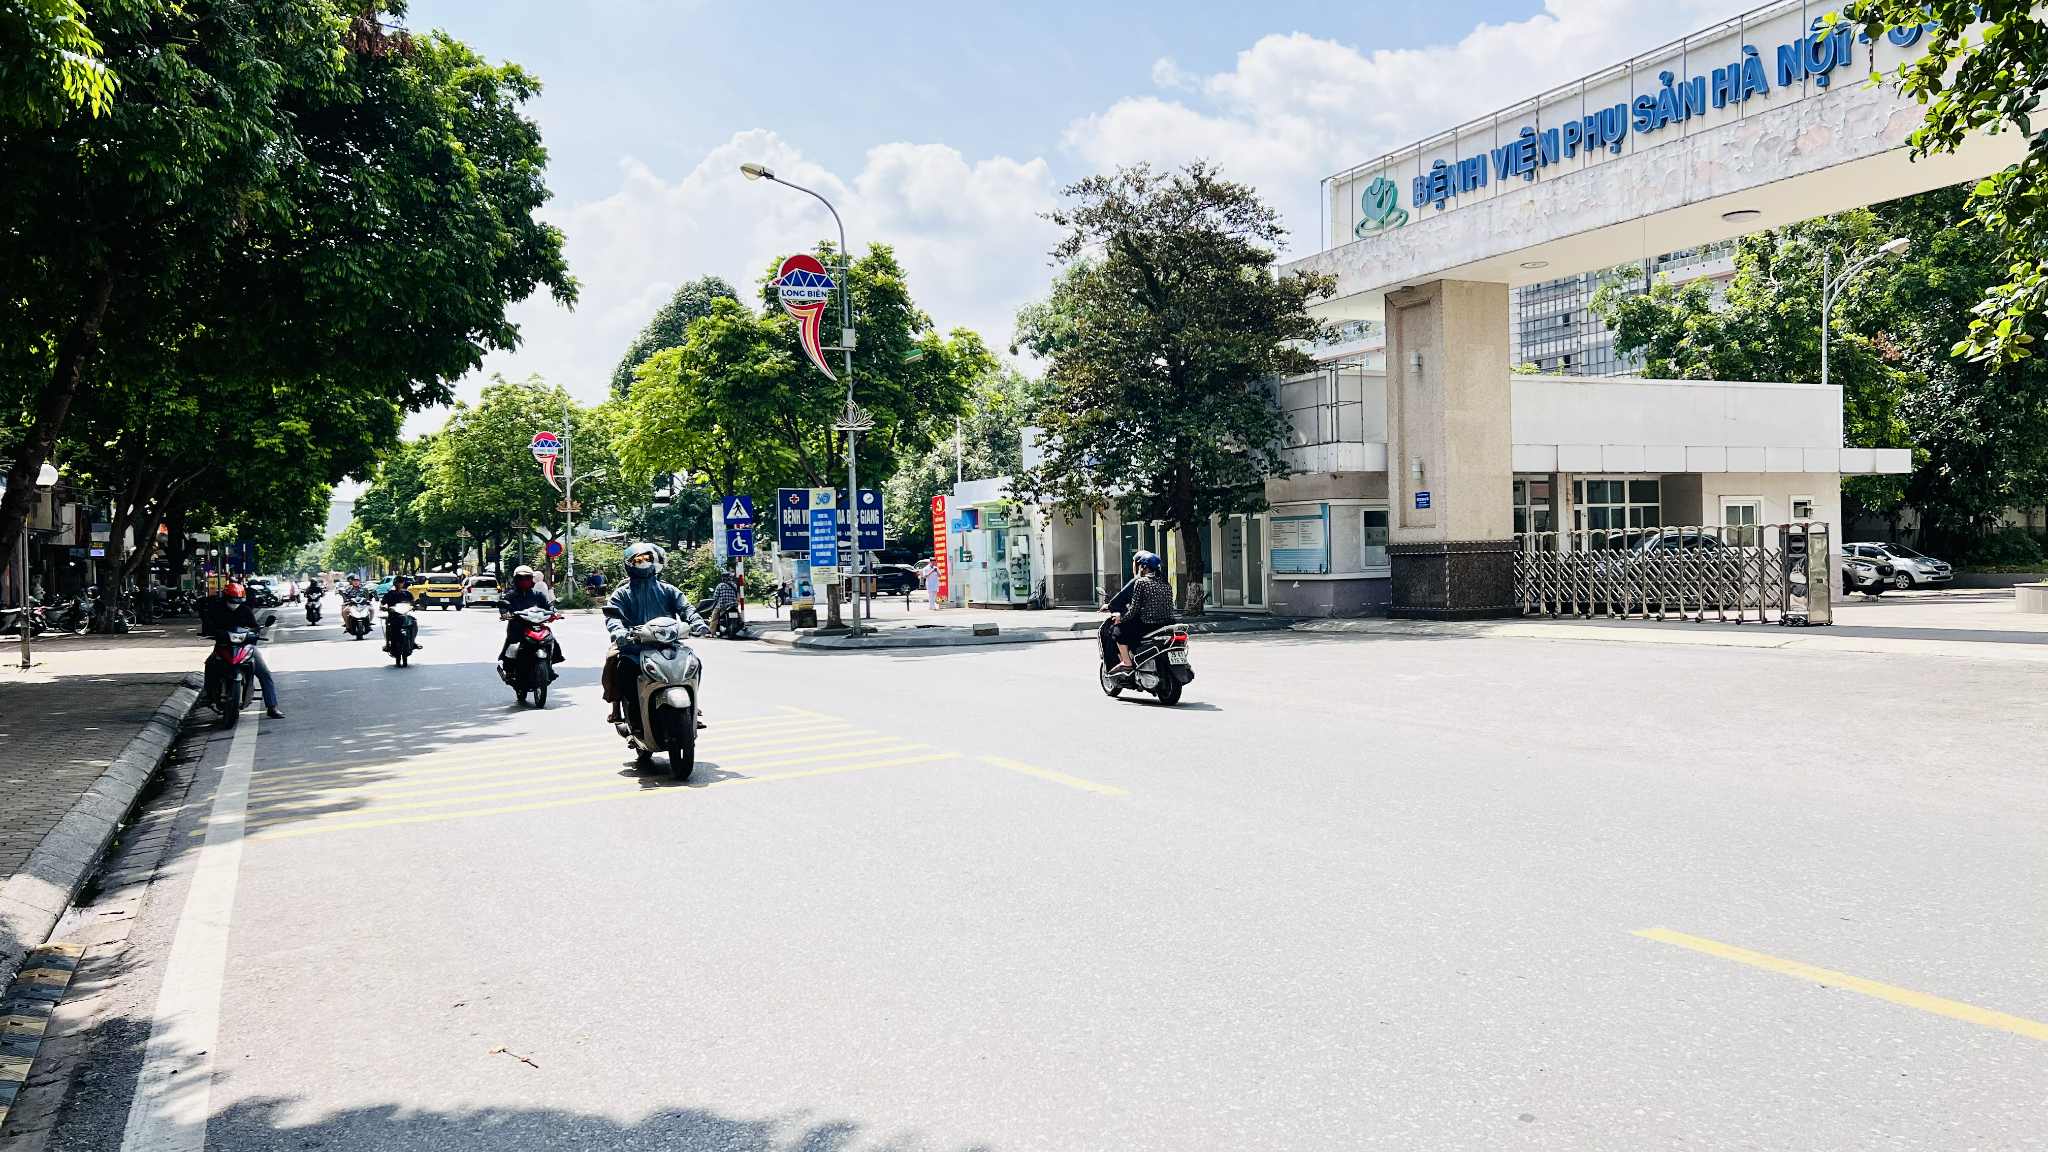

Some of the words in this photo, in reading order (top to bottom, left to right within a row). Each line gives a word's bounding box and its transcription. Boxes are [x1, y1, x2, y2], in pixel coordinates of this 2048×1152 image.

[1413, 159, 1487, 209] BỆNH
[1491, 126, 1559, 182] VIỆN
[1563, 103, 1628, 154] PHỤ
[1633, 70, 1706, 134] SẢN
[1712, 44, 1769, 109] HÀ
[1778, 15, 1852, 87] NỘI
[782, 289, 805, 297] LONG
